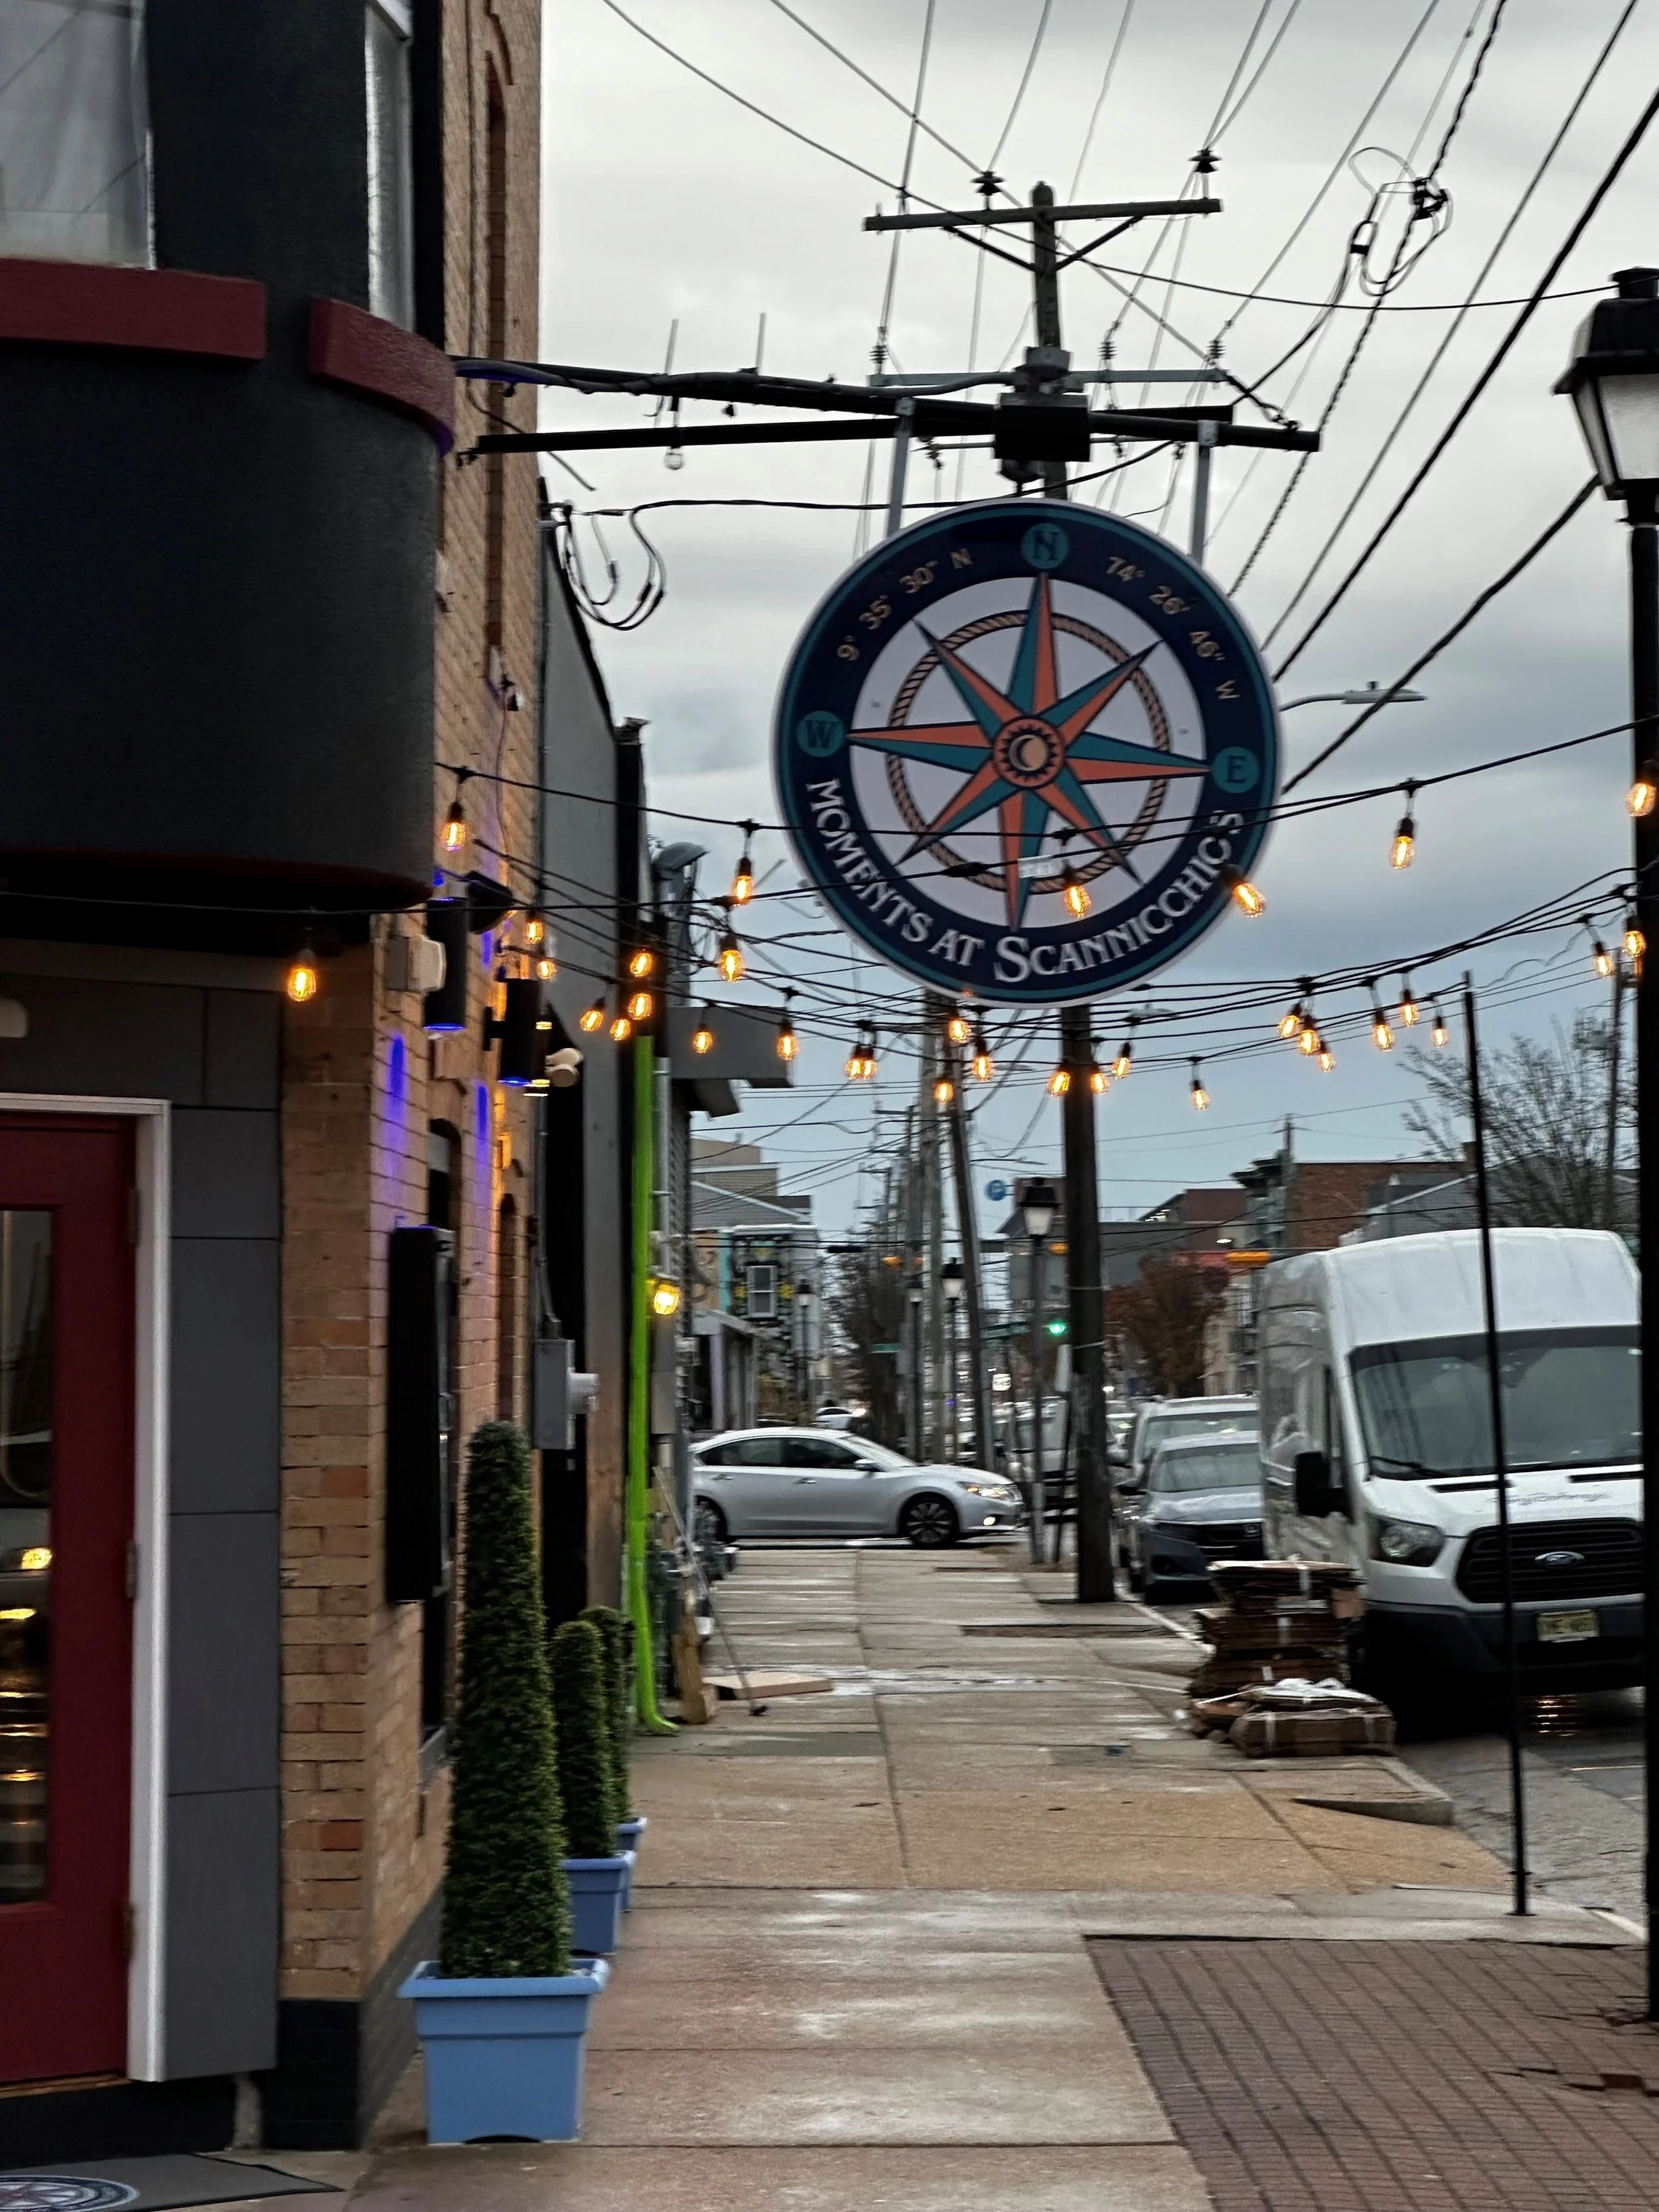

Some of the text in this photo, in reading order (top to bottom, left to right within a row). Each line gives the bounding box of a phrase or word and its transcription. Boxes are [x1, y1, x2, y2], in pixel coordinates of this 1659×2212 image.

[950, 548, 973, 569] N
[1032, 530, 1059, 561] N
[1214, 679, 1240, 700] W
[805, 719, 837, 749] W
[1226, 755, 1247, 783] E
[806, 778, 1244, 983] MOMENTS AT SCANNICCHIOS
